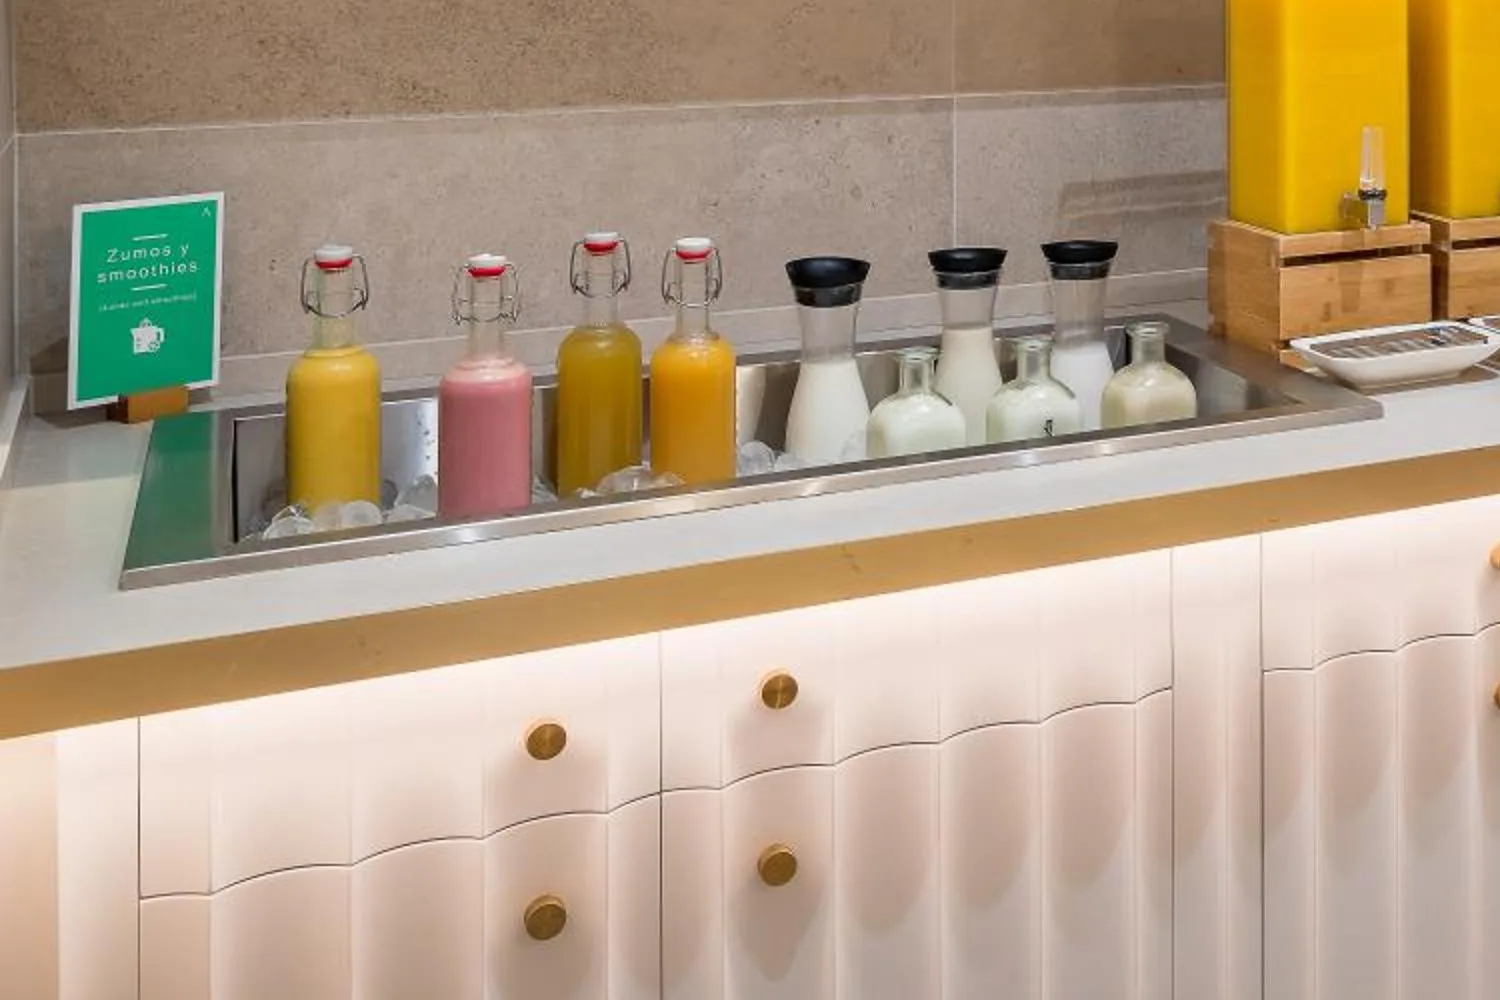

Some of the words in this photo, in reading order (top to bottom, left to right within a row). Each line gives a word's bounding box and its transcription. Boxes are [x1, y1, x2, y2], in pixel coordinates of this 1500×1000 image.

[107, 245, 171, 263] Zumos
[180, 243, 188, 256] y
[97, 261, 197, 283] smoothies
